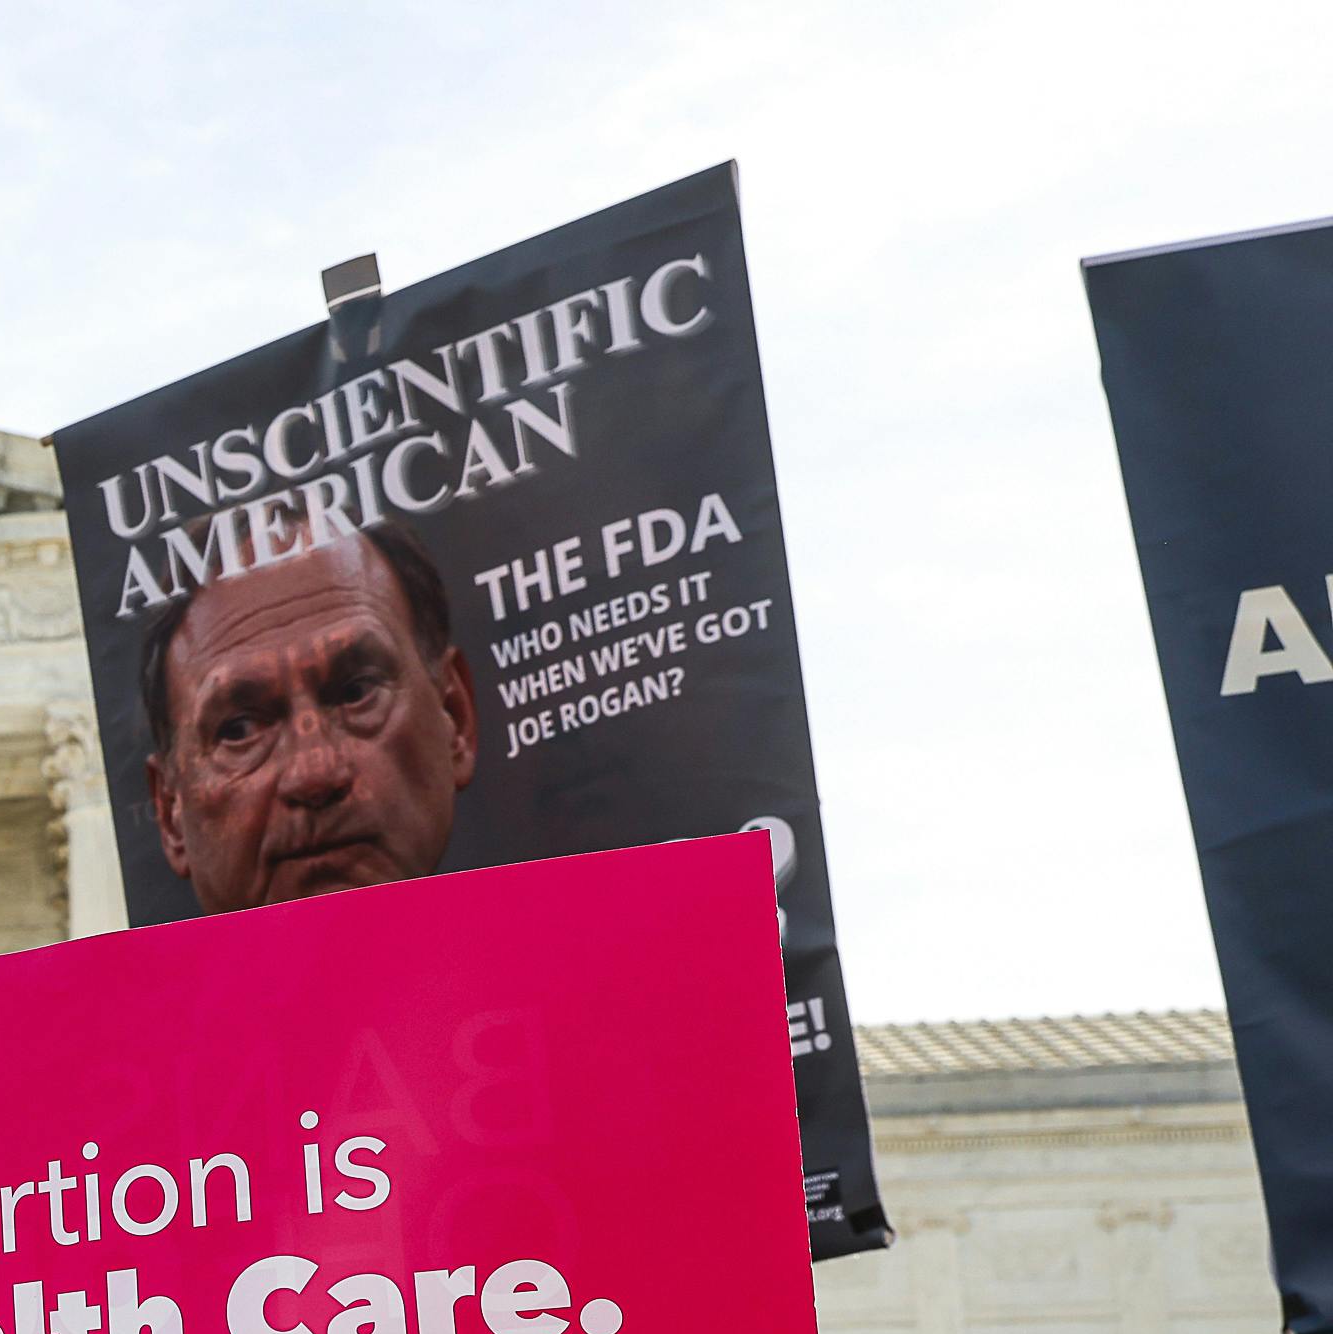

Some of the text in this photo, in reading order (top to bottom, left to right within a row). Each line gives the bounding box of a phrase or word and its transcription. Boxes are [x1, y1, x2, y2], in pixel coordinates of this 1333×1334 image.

[96, 252, 714, 543] UNSCIENTIFIC
[115, 381, 579, 621] AMERICAN
[475, 493, 743, 622] THE FDA
[491, 571, 711, 669] WHO NEEDS IT
[498, 599, 773, 711] WHEN WE'VE GOT
[1220, 574, 1333, 696] A
[505, 668, 686, 759] JOE ROGAN?
[298, 1109, 392, 1216] is
